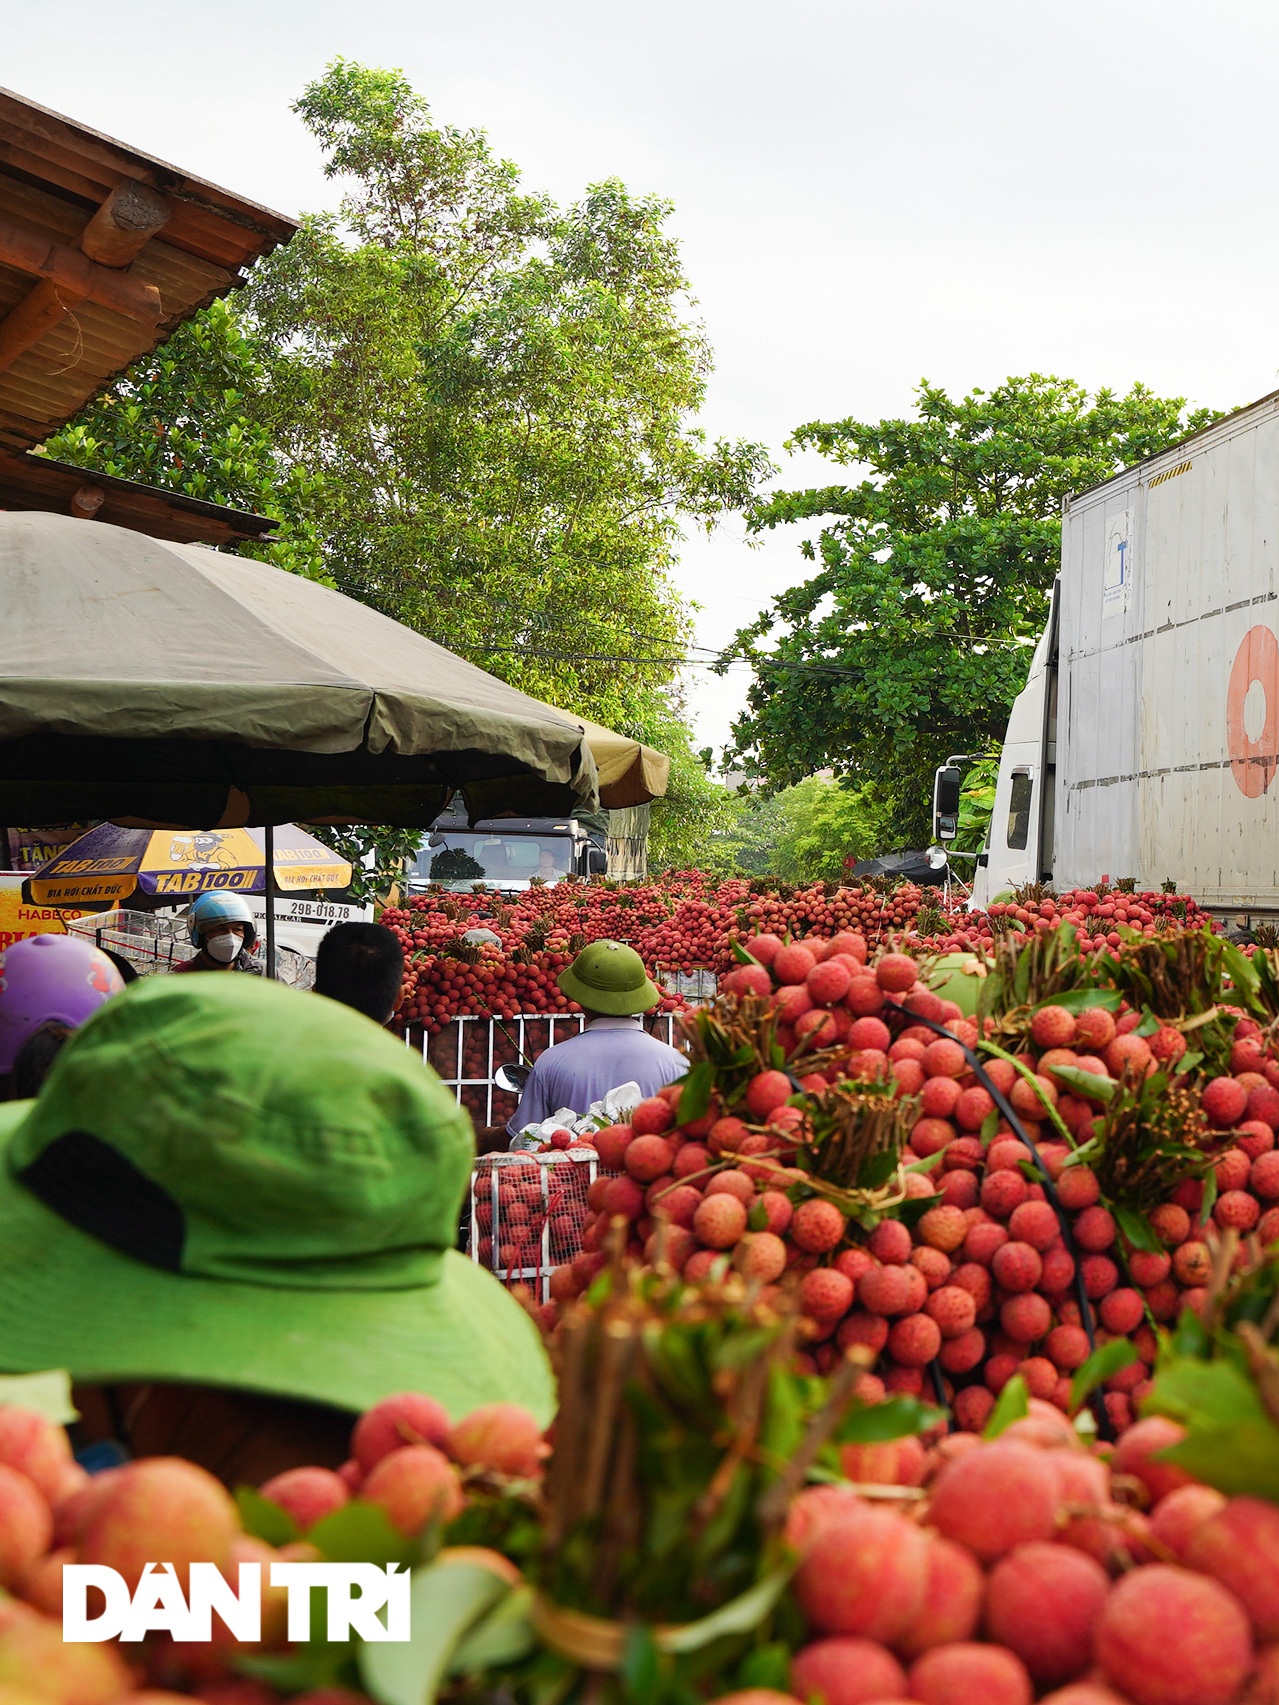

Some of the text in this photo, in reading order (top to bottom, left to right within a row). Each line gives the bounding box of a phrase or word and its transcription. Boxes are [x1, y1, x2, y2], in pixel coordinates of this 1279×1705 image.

[47, 889, 62, 898] BIA
[81, 883, 104, 896] CHẤT
[18, 909, 82, 920] HABECO
[291, 902, 350, 919] 29B-018.78
